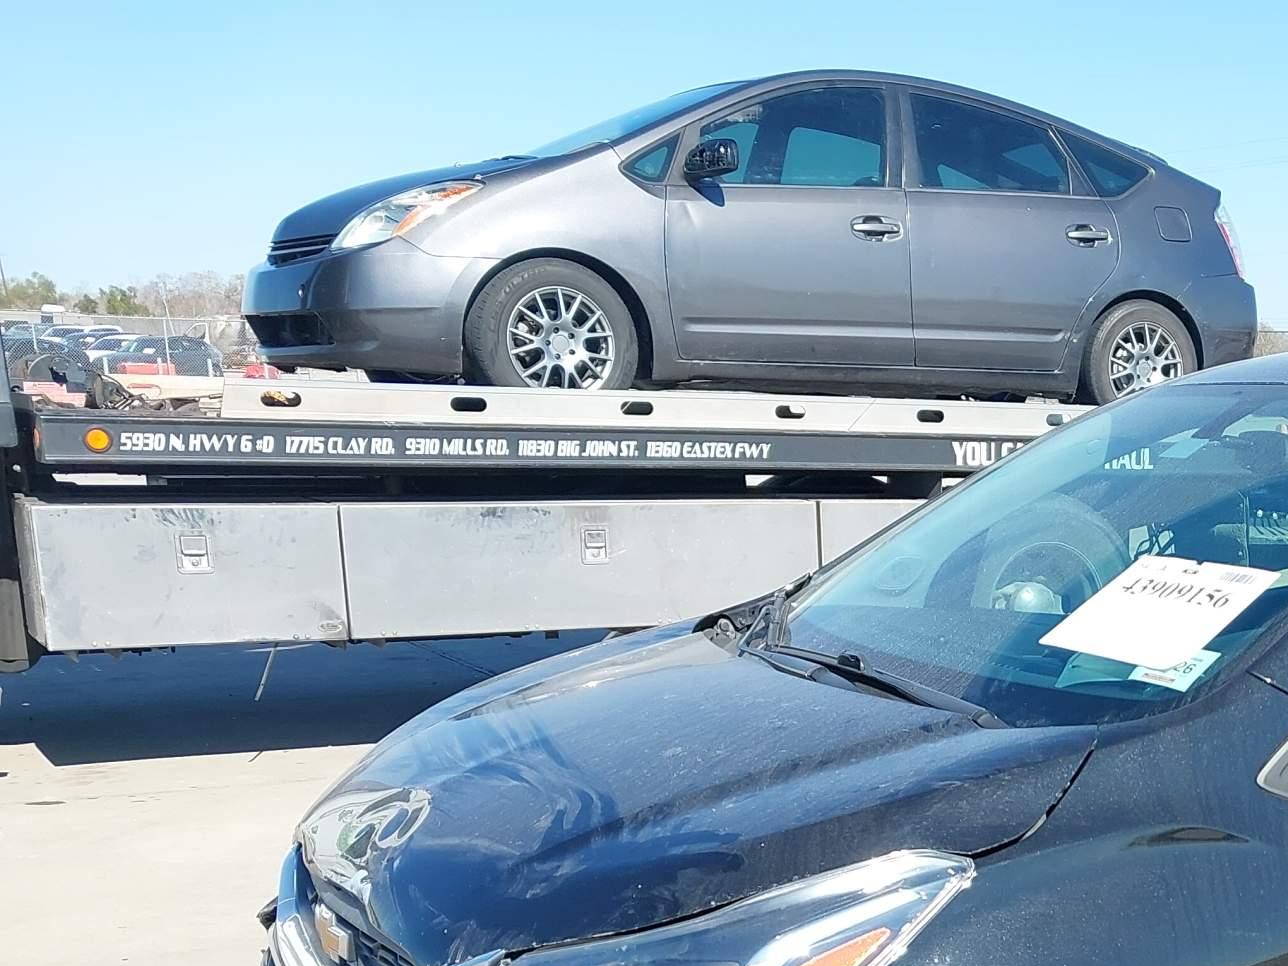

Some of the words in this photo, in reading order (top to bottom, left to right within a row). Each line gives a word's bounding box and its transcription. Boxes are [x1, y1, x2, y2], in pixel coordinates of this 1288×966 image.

[120, 433, 162, 451] 5930
[189, 434, 237, 452] HWY
[240, 435, 253, 452] 6
[285, 436, 325, 454] 17715
[327, 437, 368, 454] CLAY
[371, 438, 395, 455] RD.
[406, 438, 440, 455] 9310
[442, 439, 484, 455] MILLS
[518, 440, 553, 456] 11830
[557, 441, 580, 457] BIG
[582, 441, 620, 457] JOHN
[646, 441, 680, 457] 11360
[682, 442, 733, 458] EASTEX
[735, 443, 771, 459] FWY
[952, 441, 995, 466] YOU
[1122, 577, 1232, 608] 43909156
